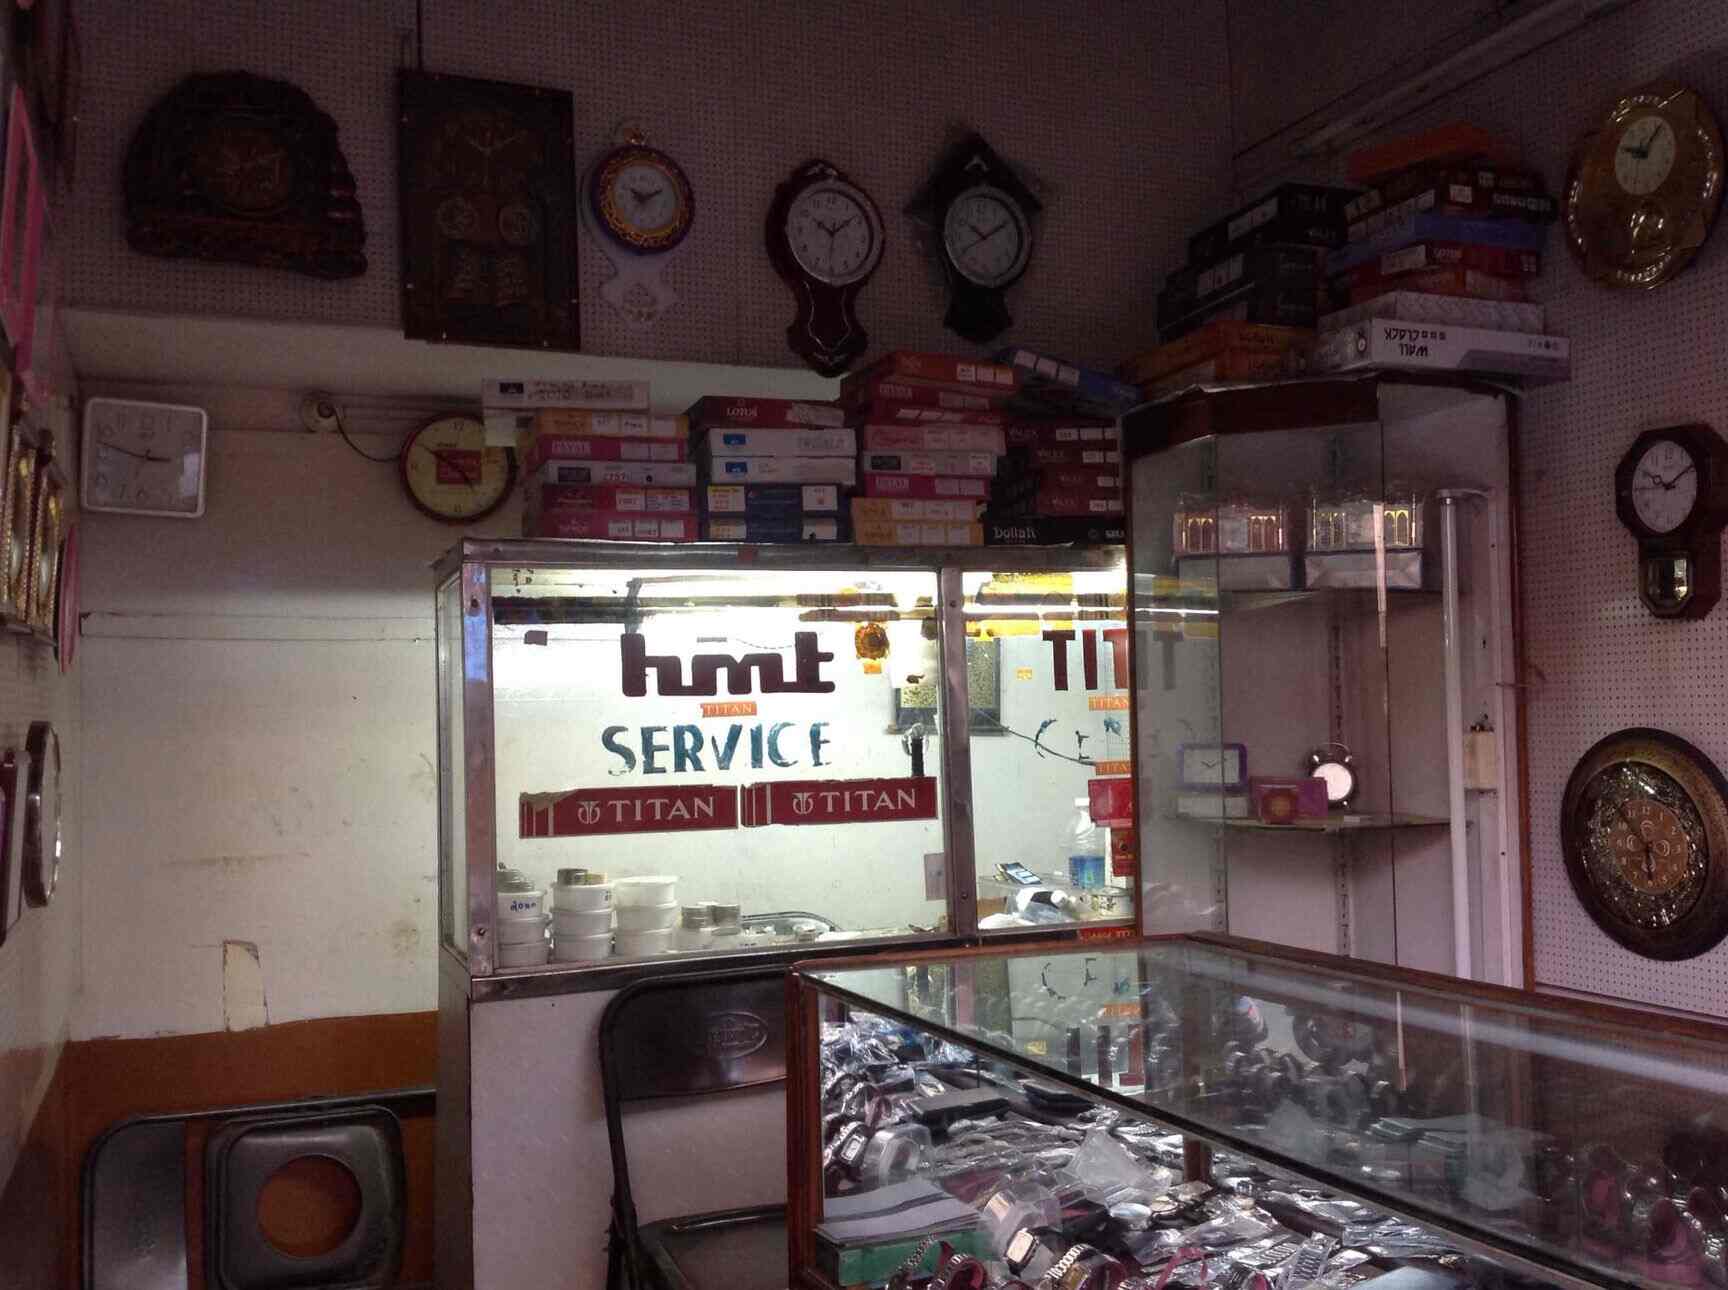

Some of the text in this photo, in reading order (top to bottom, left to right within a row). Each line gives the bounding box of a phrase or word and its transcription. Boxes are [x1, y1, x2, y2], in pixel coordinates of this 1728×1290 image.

[620, 631, 836, 697] hmt
[704, 703, 752, 715] TITAN
[602, 721, 831, 776] SERVICE
[610, 796, 714, 823] TITAN
[820, 788, 916, 814] TITAN
